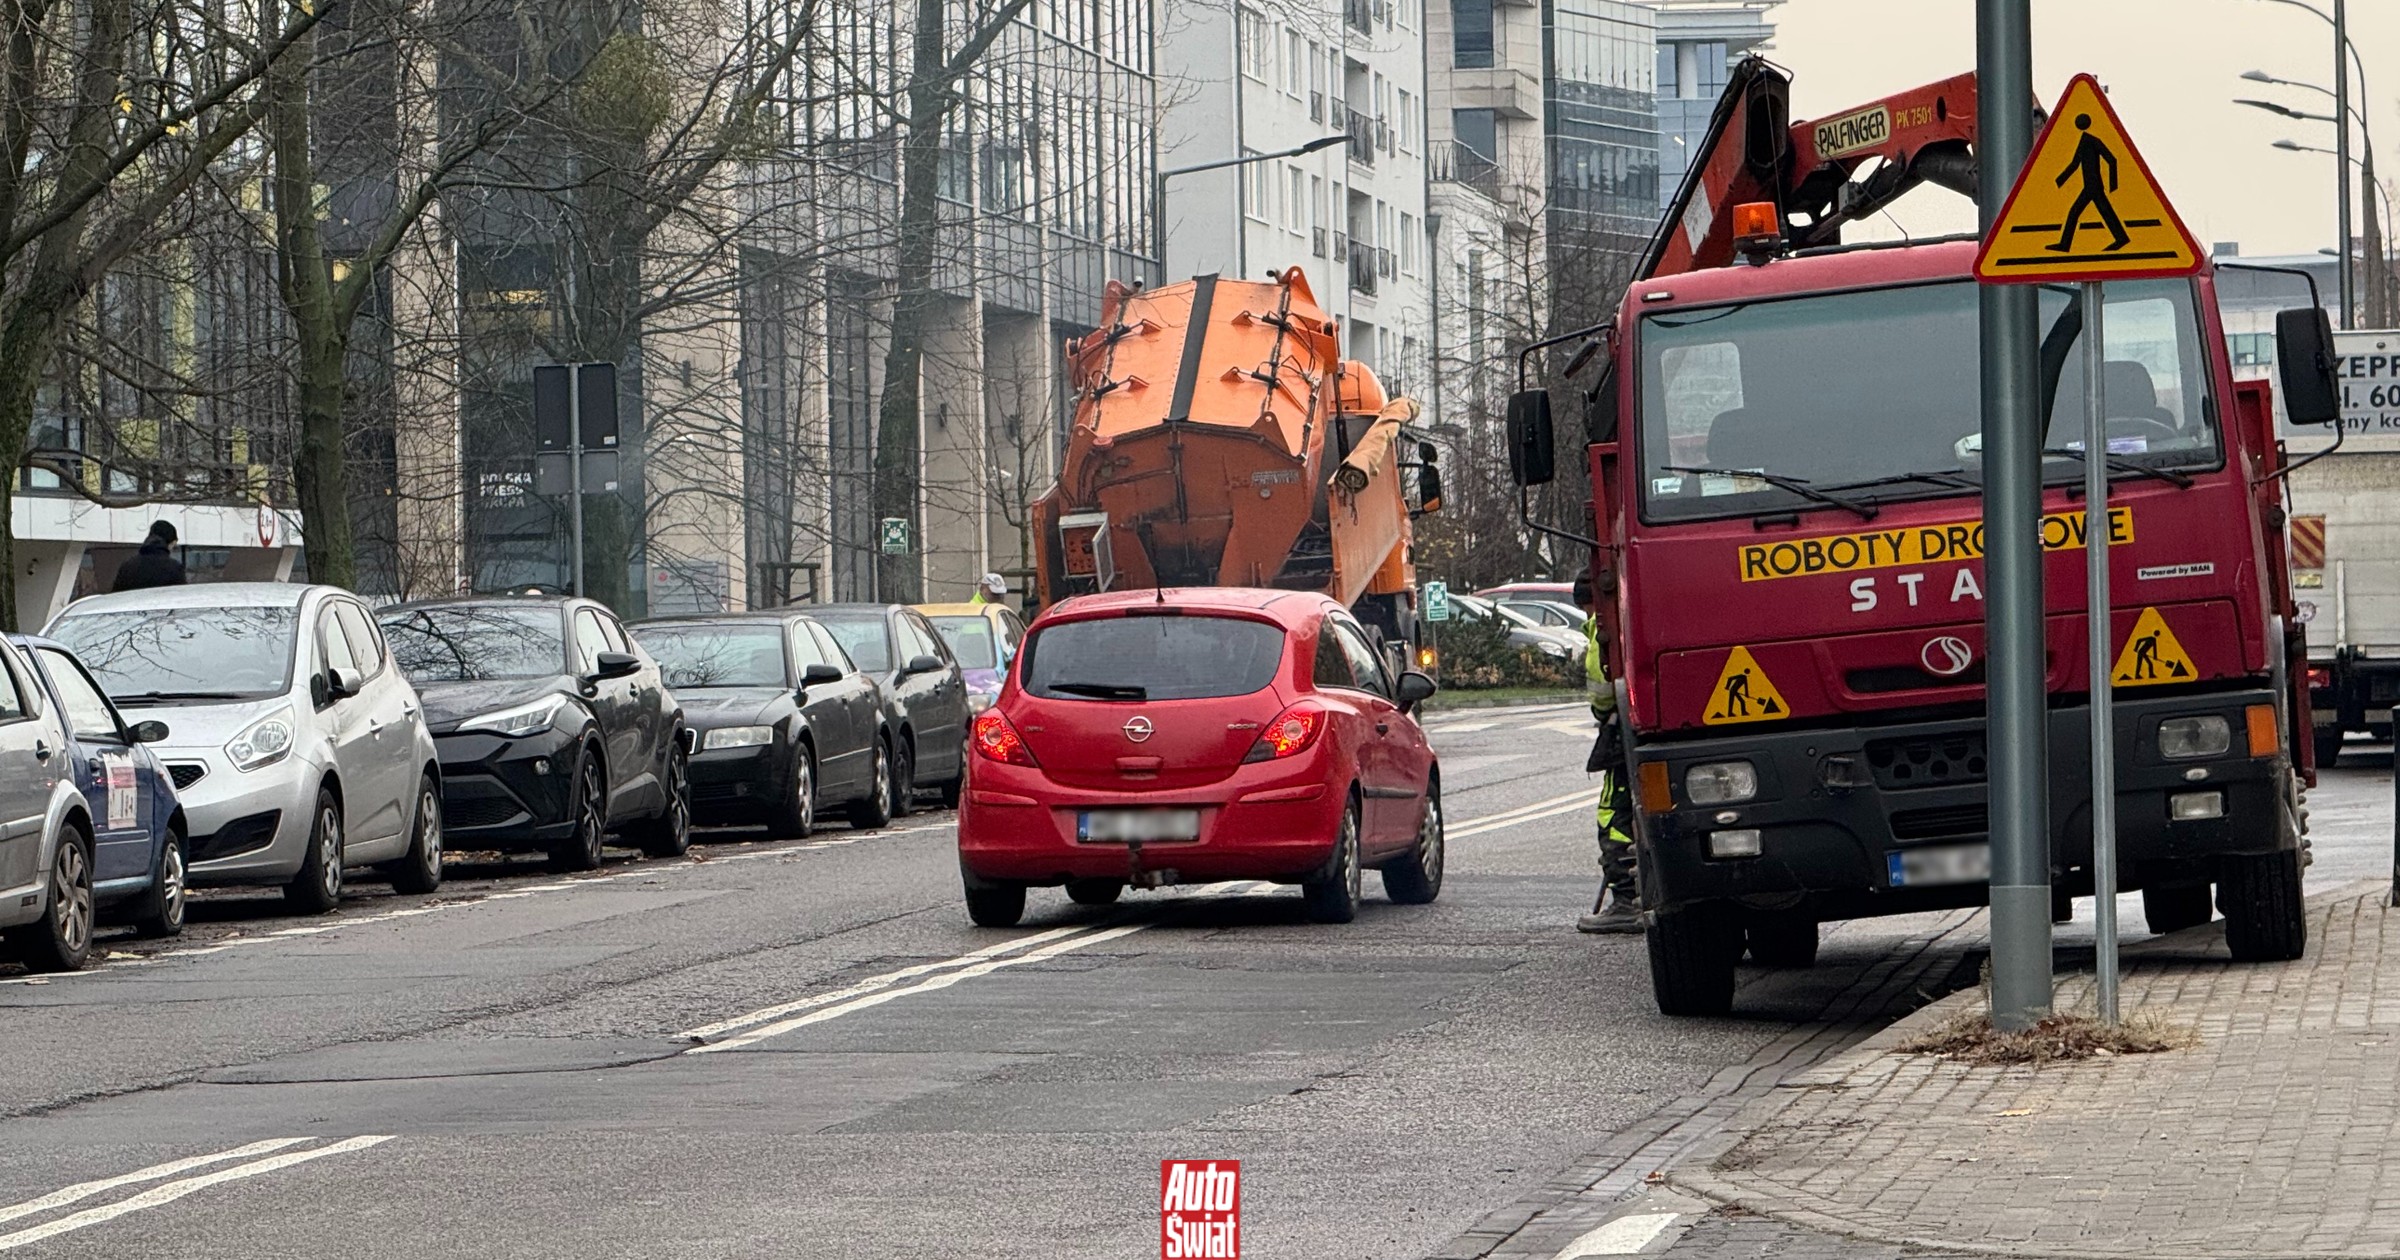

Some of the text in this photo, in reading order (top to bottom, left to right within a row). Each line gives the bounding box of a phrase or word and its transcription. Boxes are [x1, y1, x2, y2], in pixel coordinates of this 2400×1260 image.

[1818, 106, 1933, 154] PALFINGER PK 7501
[1744, 531, 1906, 579] ROBOTY
[2140, 563, 2211, 578] Powered by MAN
